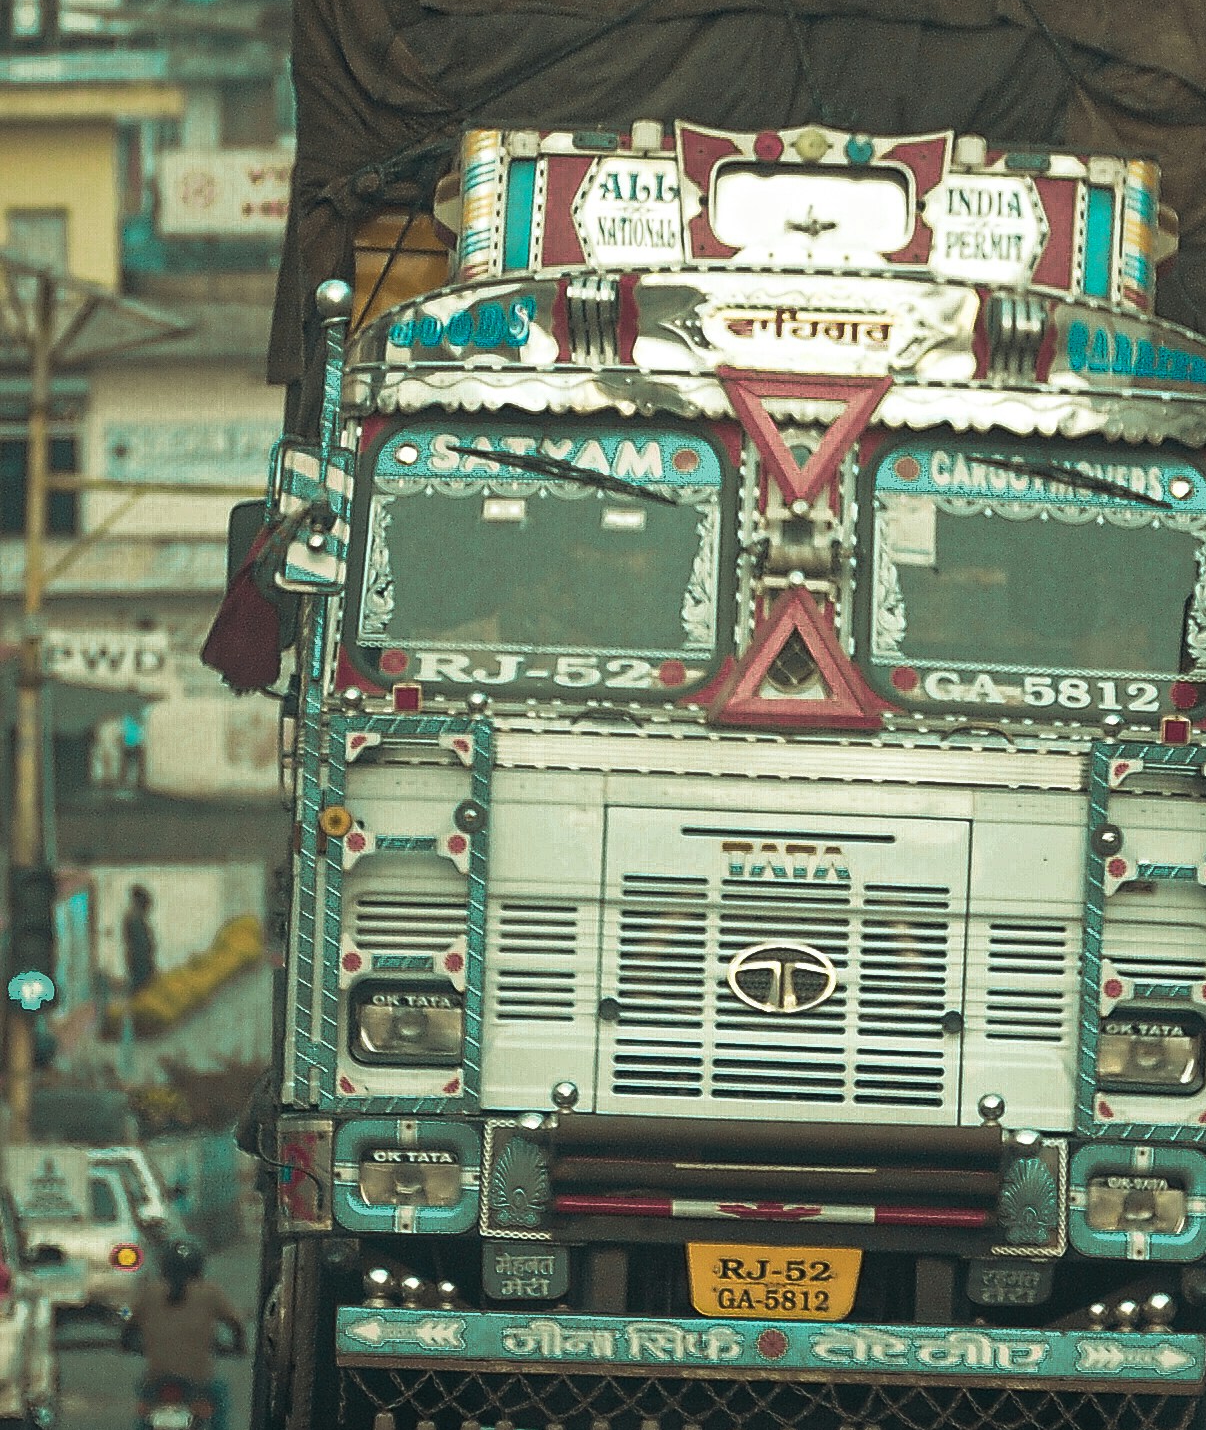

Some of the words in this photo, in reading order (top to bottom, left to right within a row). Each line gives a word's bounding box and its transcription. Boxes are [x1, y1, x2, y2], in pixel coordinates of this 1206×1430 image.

[598, 173, 680, 202] ALL
[947, 189, 1023, 219] INDIA
[597, 216, 677, 248] NATIONAL
[945, 230, 1024, 262] PERMIT
[388, 295, 537, 348] GOODS
[428, 433, 664, 478] SATYAM
[413, 651, 652, 689] RJ-52
[721, 842, 851, 880] TATA
[372, 994, 400, 1006] OK
[403, 995, 452, 1008] TATA
[1105, 1023, 1133, 1035] OK
[1138, 1024, 1185, 1037] TATA
[372, 1150, 402, 1163] OK
[405, 1151, 454, 1164] TATA
[494, 1252, 556, 1277] मेहनत
[718, 1258, 835, 1283] RJ-52
[717, 1287, 830, 1313] GA-5812
[502, 1320, 621, 1359] जीना
